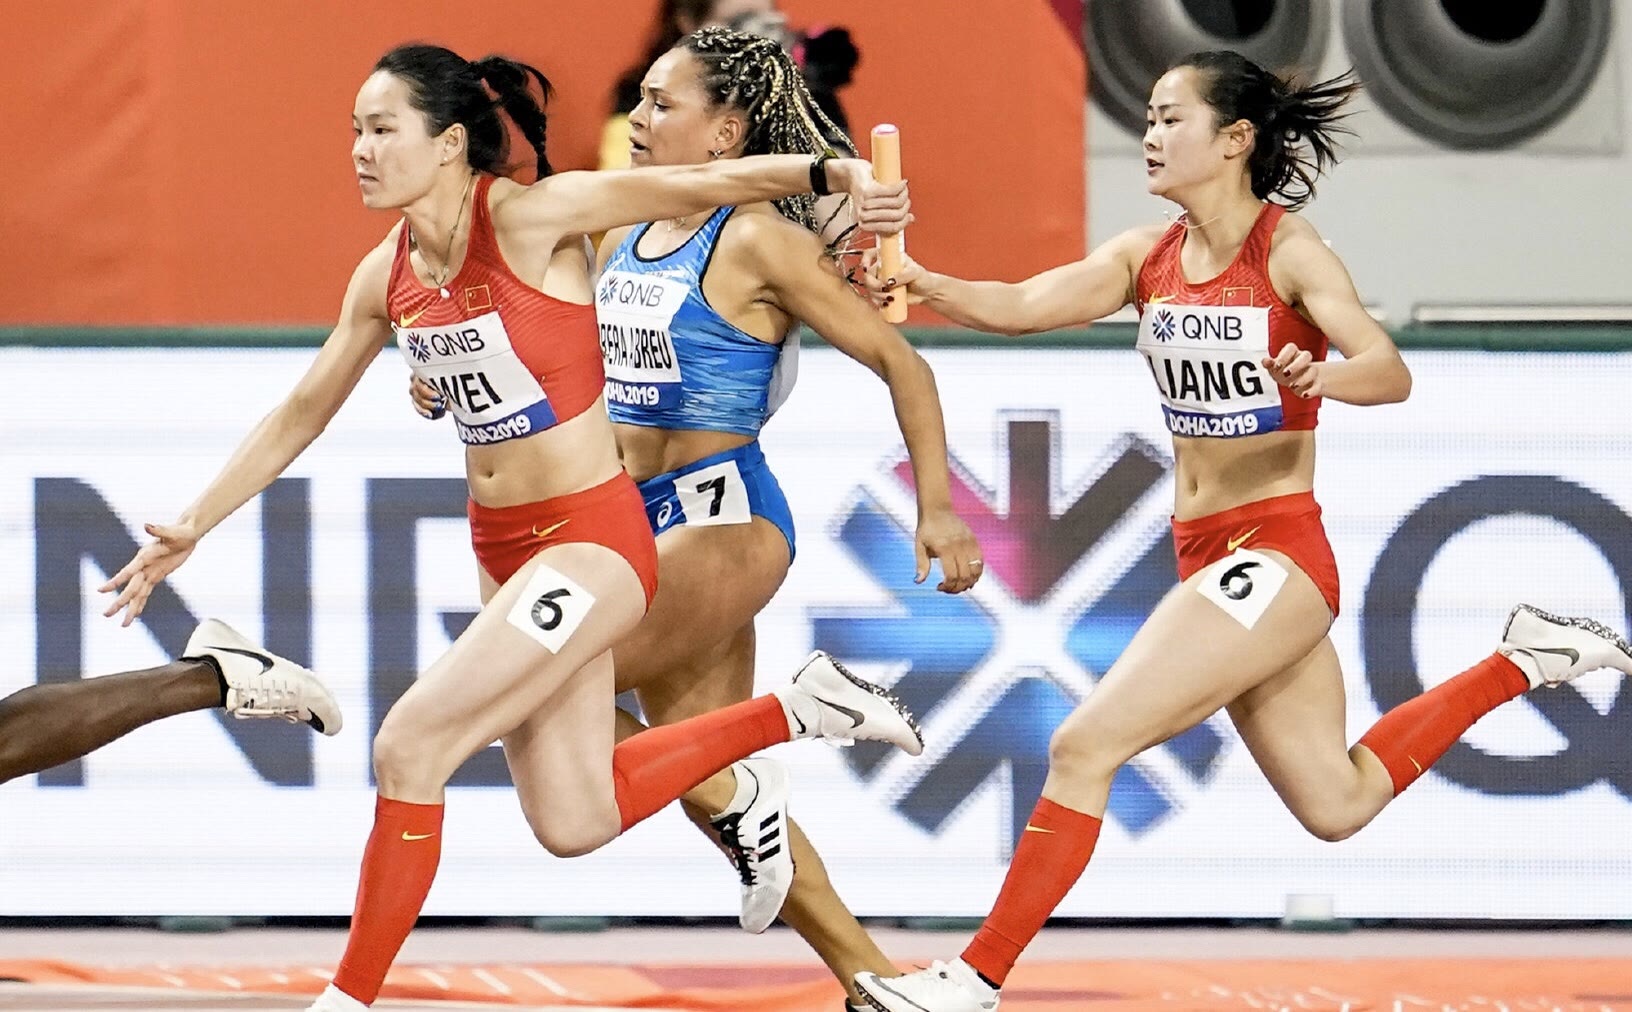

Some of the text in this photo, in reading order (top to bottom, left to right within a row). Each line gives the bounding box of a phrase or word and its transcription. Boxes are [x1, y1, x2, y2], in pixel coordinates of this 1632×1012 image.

[620, 280, 664, 307] QNB
[430, 328, 485, 357] QNB
[1182, 314, 1242, 340] QNB
[428, 372, 502, 413] WEI
[1147, 355, 1263, 402] LIANG
[1169, 413, 1258, 436] DOHA2019
[696, 476, 726, 517] 7
[1220, 561, 1263, 600] 6
[530, 588, 571, 631] 6
